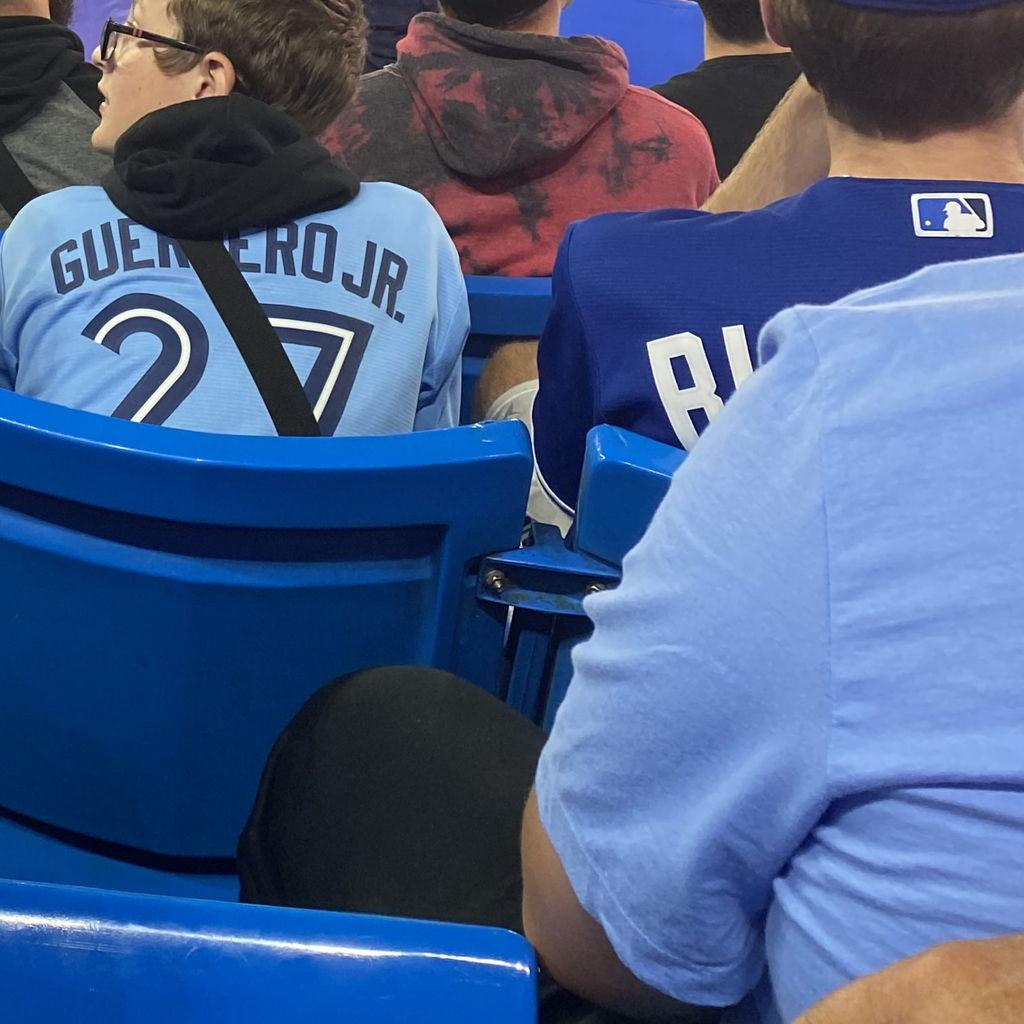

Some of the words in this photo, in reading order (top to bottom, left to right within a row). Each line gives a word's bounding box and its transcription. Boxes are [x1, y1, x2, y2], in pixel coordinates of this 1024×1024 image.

[50, 216, 338, 295] GUERERO
[341, 241, 408, 324] JR.
[81, 292, 374, 437] 27
